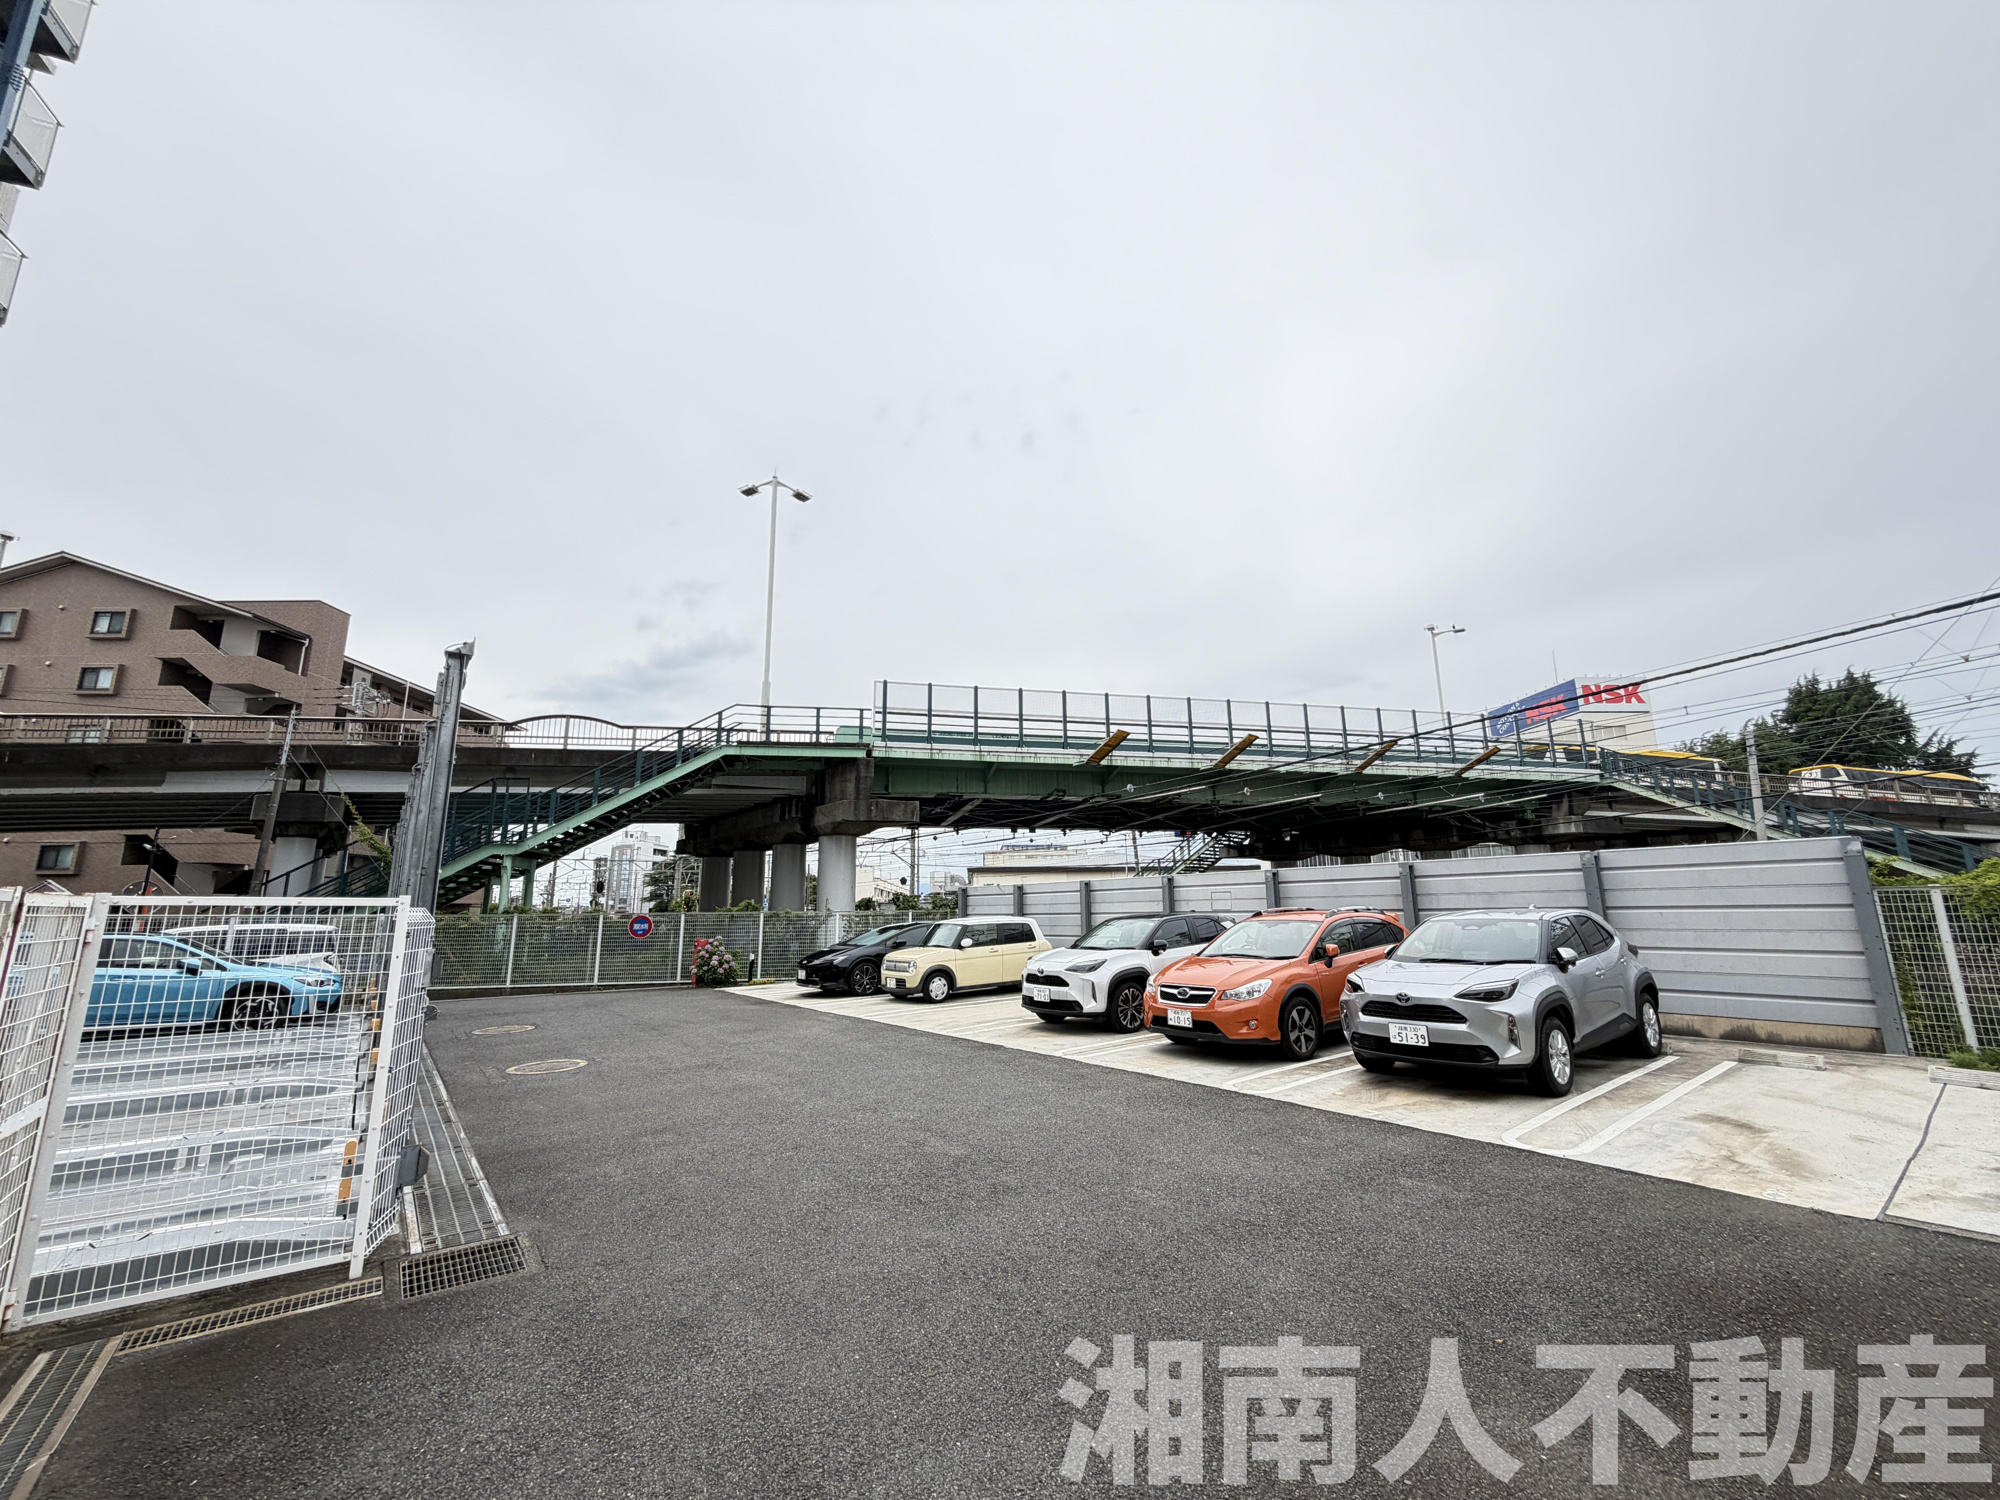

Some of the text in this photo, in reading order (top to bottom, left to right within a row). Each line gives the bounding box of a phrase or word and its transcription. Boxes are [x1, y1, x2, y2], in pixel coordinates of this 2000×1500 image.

[1581, 684, 1646, 704] NSK
[1525, 693, 1568, 725] NSK
[1173, 1015, 1192, 1026] 10-15
[1397, 1032, 1426, 1044] 51-39
